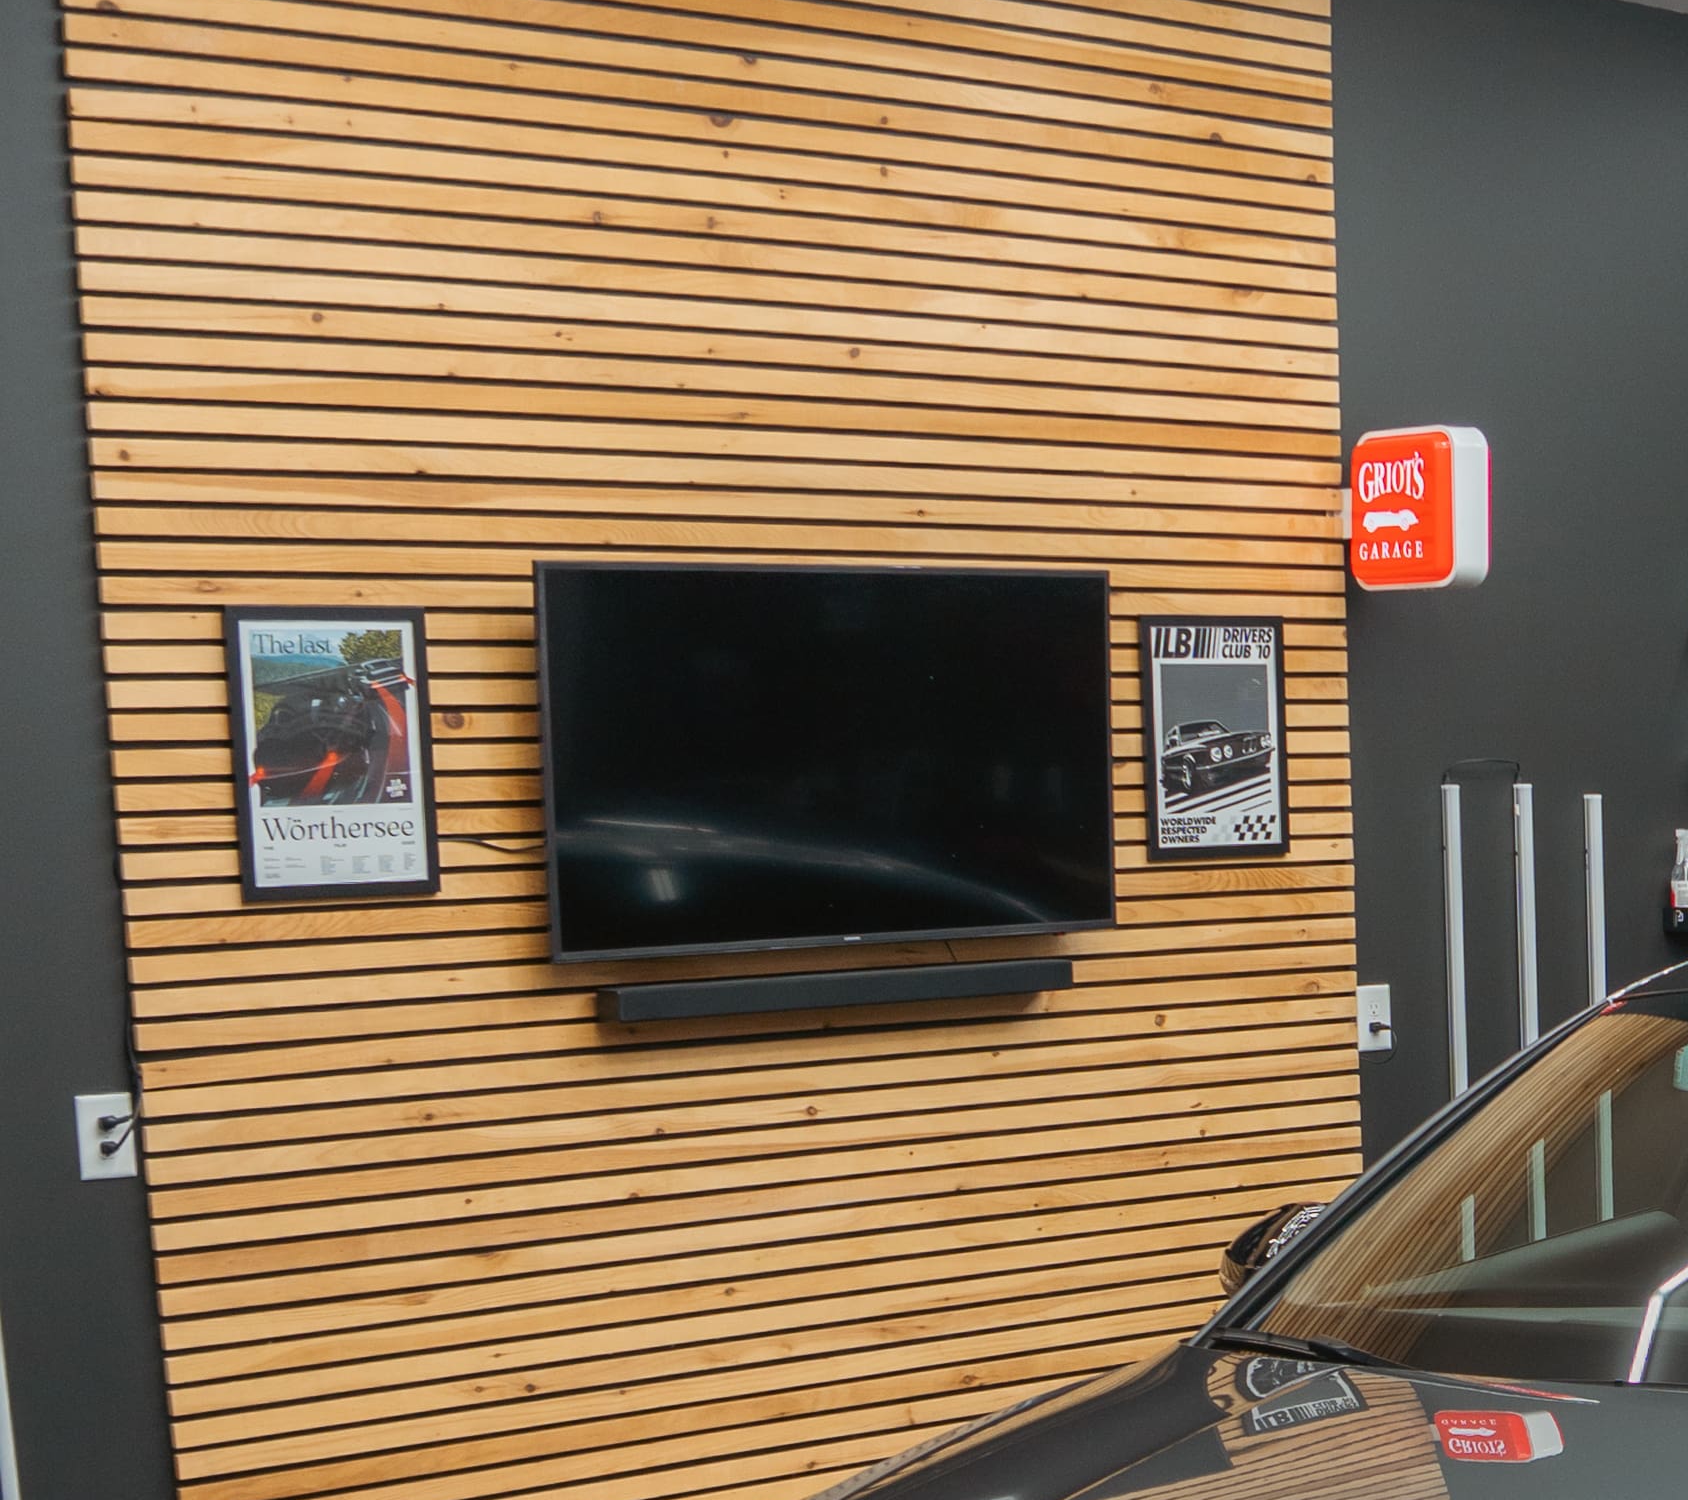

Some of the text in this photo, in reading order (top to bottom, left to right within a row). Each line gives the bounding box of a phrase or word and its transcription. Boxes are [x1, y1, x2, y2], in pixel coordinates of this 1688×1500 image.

[1358, 451, 1424, 503] GRIOT'S
[1359, 540, 1423, 561] GARAGE
[1223, 627, 1273, 643] DRIVERS
[253, 633, 333, 654] The last
[1222, 644, 1252, 659] CLUB
[261, 816, 415, 842] Wörthersee
[1160, 816, 1217, 826] WORLDWIDE
[1161, 826, 1208, 836] RESPECTED
[1161, 835, 1200, 844] OWNERS
